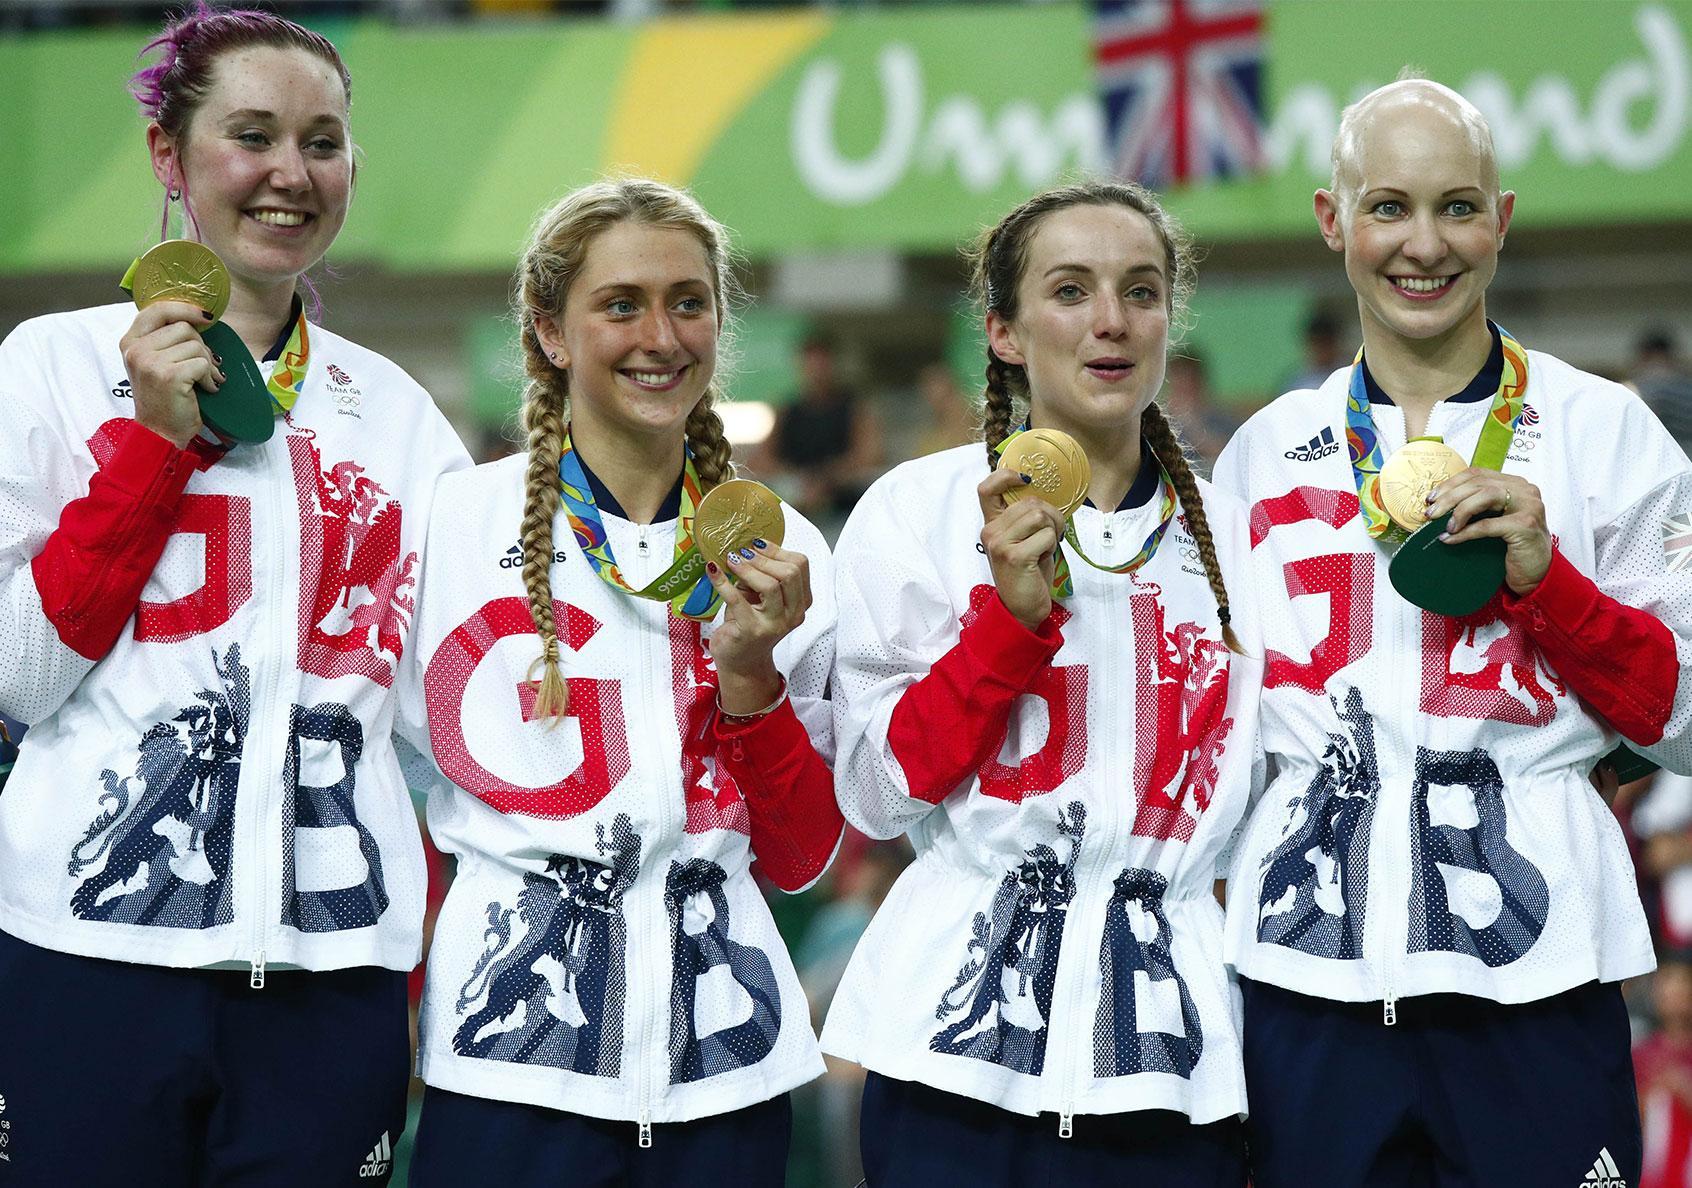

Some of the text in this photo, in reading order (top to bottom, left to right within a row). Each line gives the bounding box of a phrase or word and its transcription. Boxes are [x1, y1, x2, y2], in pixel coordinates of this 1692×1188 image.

[1284, 442, 1340, 462] adidas
[1174, 534, 1196, 547] TEAM
[1181, 564, 1207, 578] Rio2016
